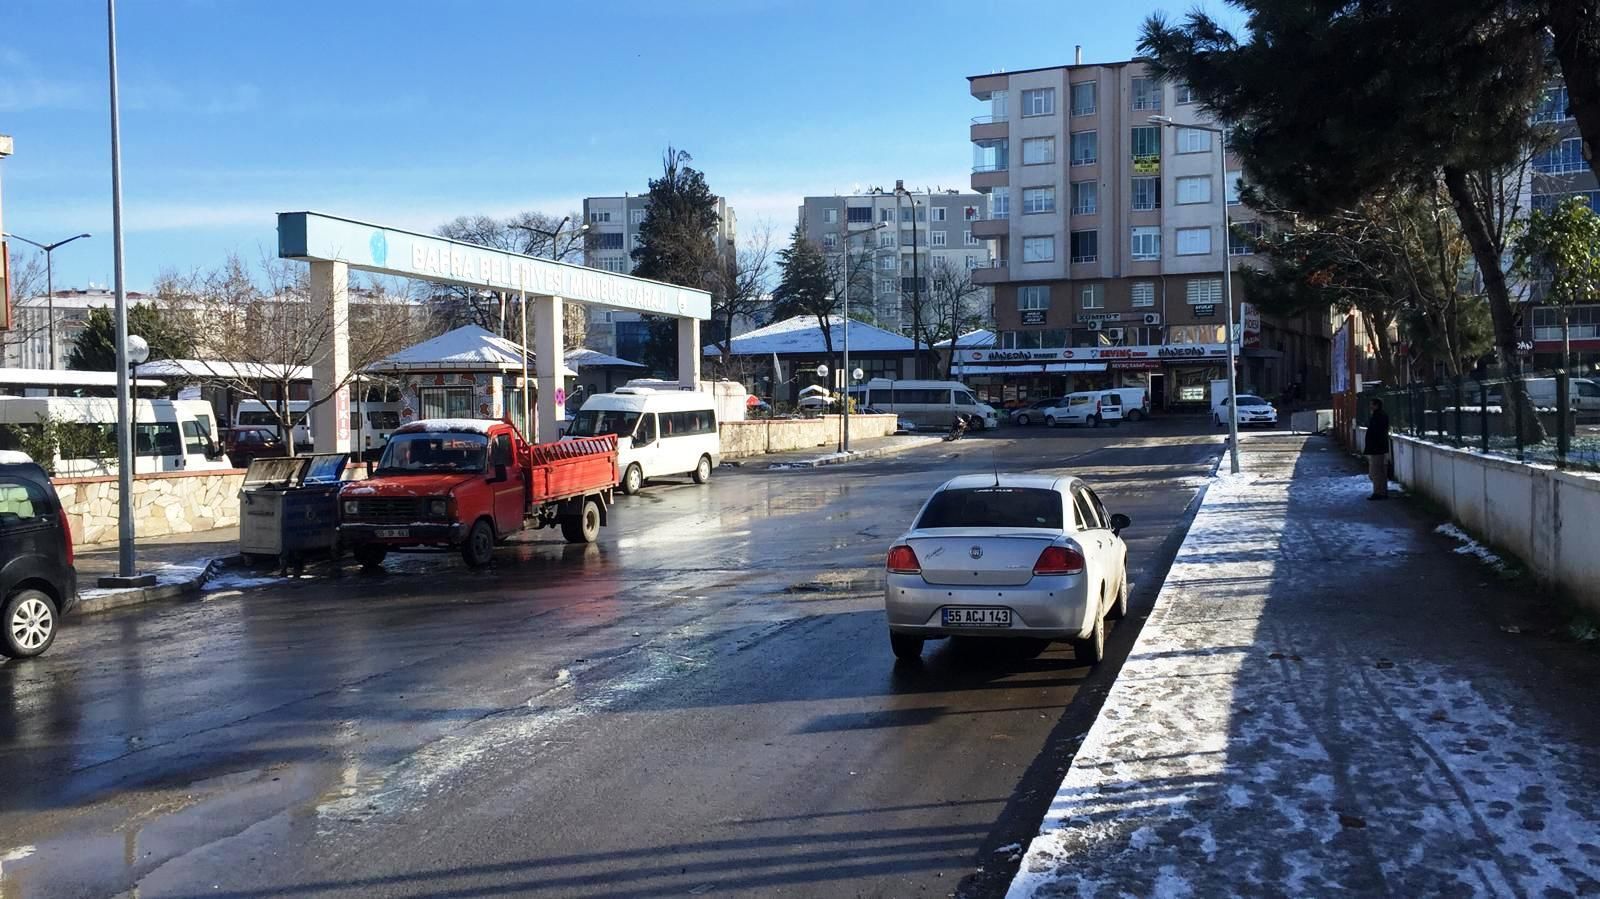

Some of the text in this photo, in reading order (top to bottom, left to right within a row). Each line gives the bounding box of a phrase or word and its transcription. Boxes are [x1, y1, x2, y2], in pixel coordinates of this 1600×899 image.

[411, 242, 474, 279] BAFRA
[988, 350, 1031, 360] HANEDAN
[1158, 346, 1205, 357] HANEDAN
[948, 610, 961, 622] 55
[965, 610, 985, 622] ACJ
[989, 610, 1009, 622] 143
